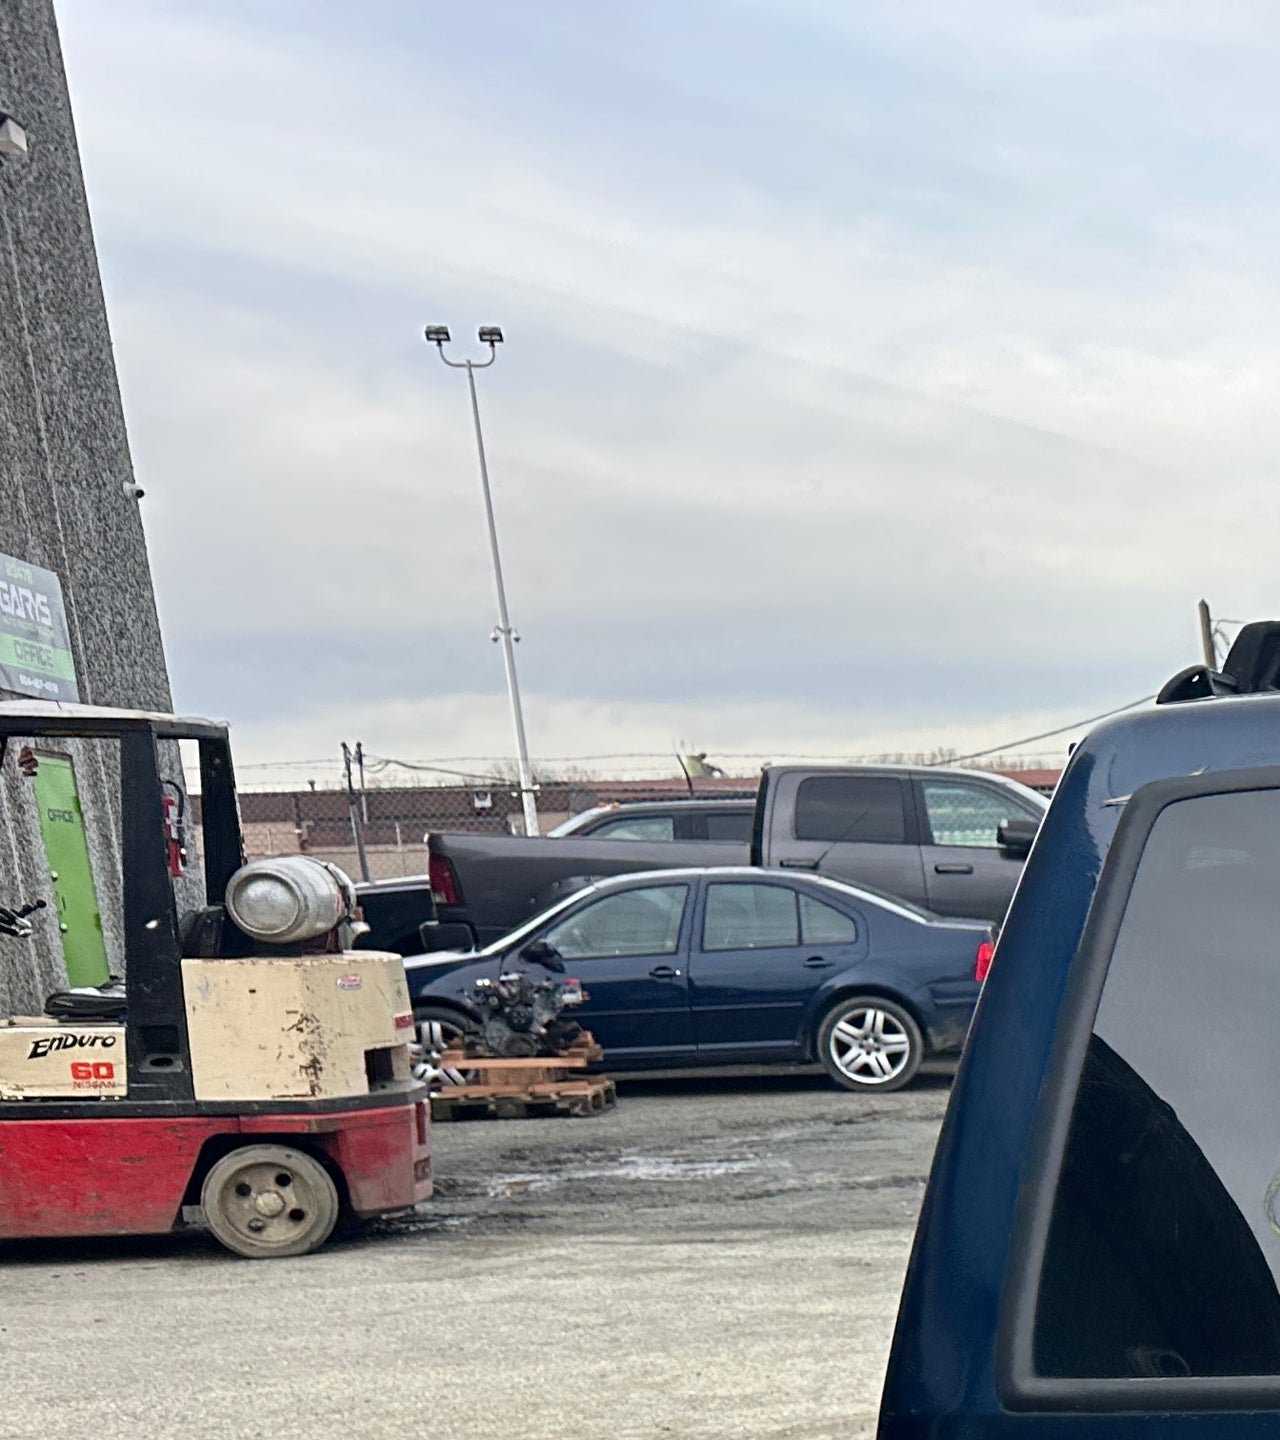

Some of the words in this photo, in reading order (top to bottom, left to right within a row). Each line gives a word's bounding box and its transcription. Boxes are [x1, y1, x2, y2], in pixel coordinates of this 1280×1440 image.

[13, 638, 55, 668] OFFICE
[47, 808, 74, 824] OFFICE
[70, 1062, 115, 1080] 60
